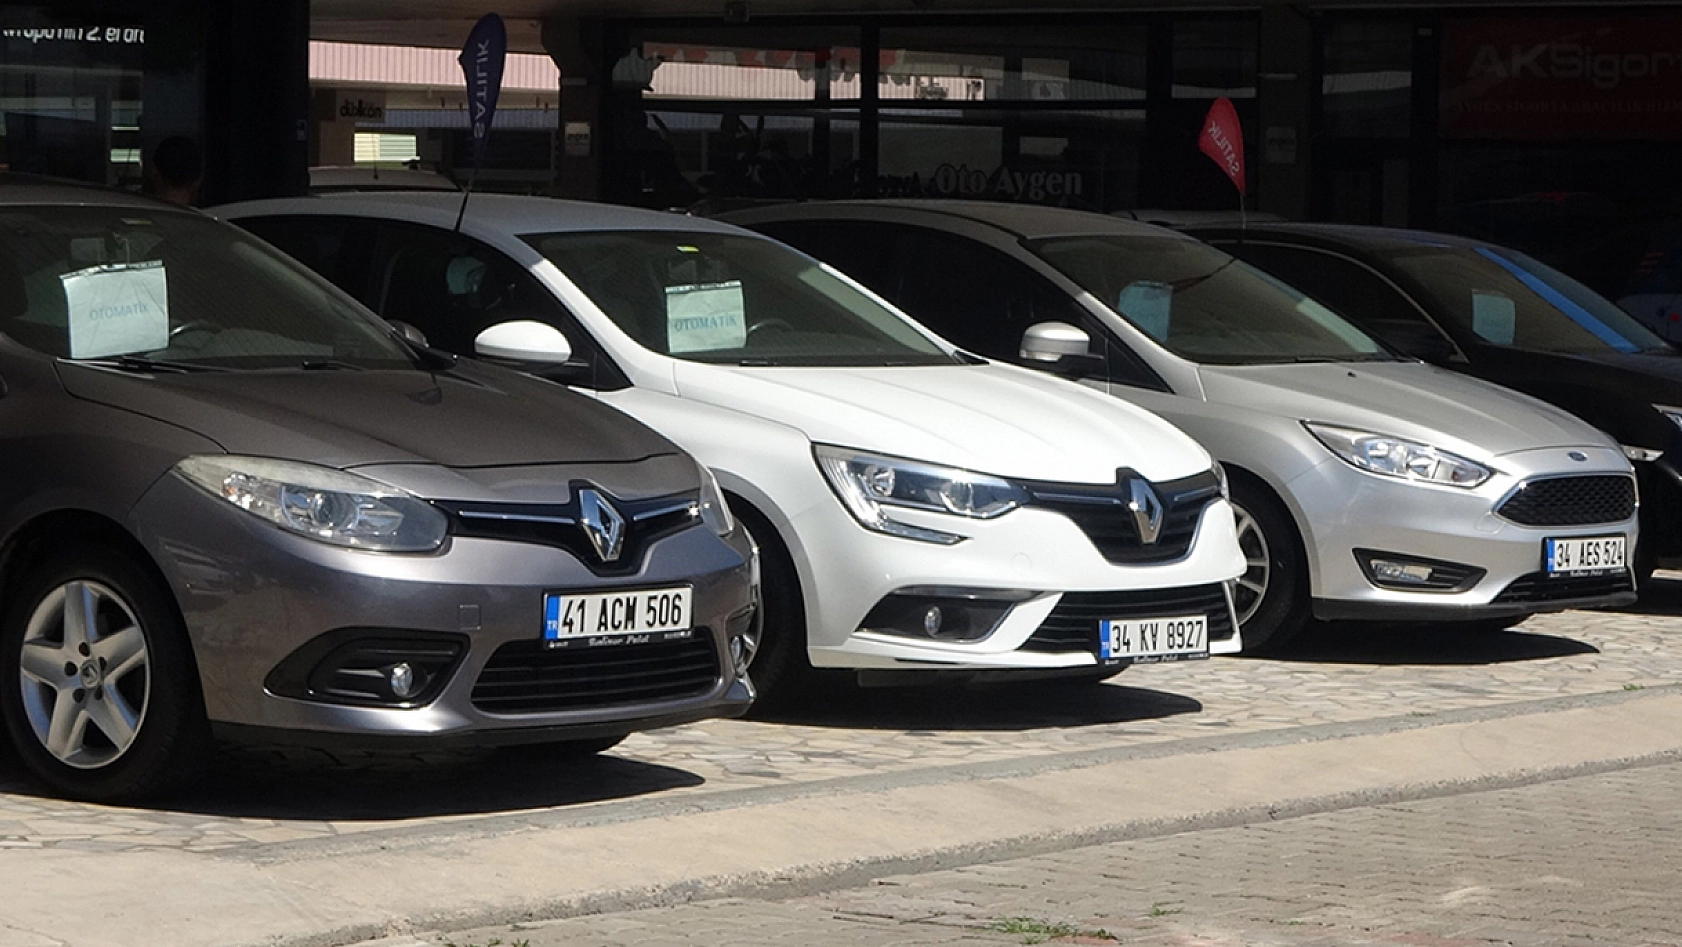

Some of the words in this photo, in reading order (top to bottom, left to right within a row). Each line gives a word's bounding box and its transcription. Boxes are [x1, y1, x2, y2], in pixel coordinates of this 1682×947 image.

[935, 163, 988, 194] Oto
[994, 166, 1082, 200] Aygen
[1557, 542, 1571, 567] 34
[1579, 541, 1600, 567] AES
[1604, 540, 1623, 565] 524
[562, 598, 587, 634] 41
[597, 595, 638, 632] ACM
[646, 593, 683, 628] 506
[1112, 624, 1131, 653] 34
[1167, 620, 1204, 649] 8927
